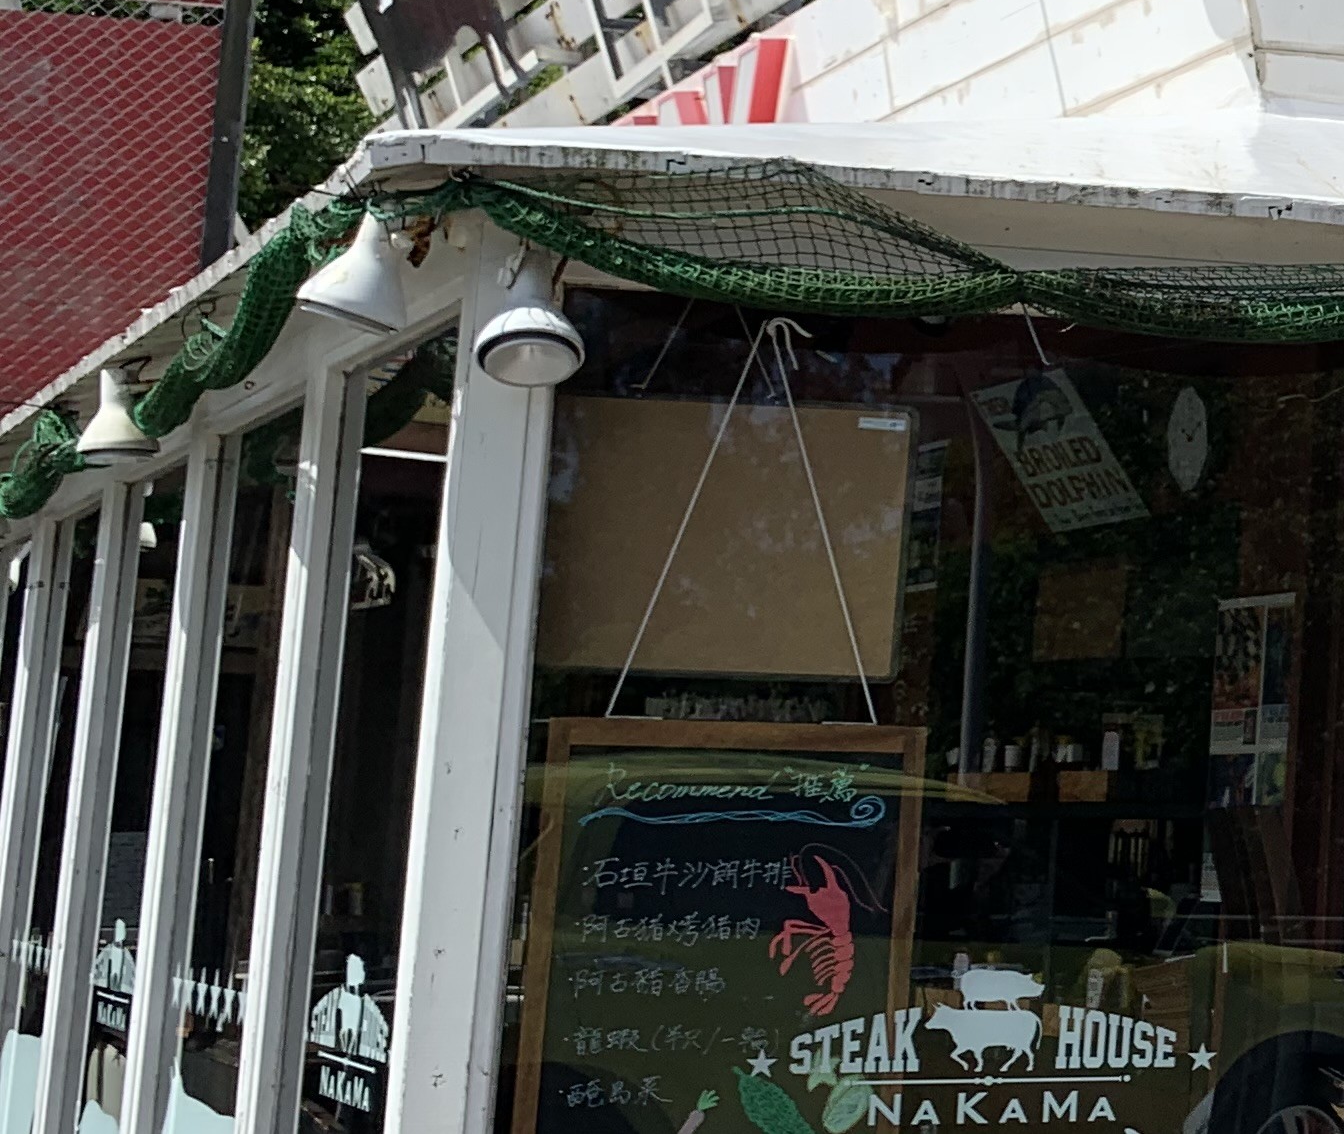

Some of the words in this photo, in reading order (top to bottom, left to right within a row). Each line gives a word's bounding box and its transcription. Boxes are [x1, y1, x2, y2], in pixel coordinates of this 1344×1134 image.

[1028, 467, 1130, 509] DOLPHIN
[595, 761, 781, 807] Recommend
[789, 1009, 924, 1075] STEAK
[1056, 1004, 1177, 1069] HOUSE
